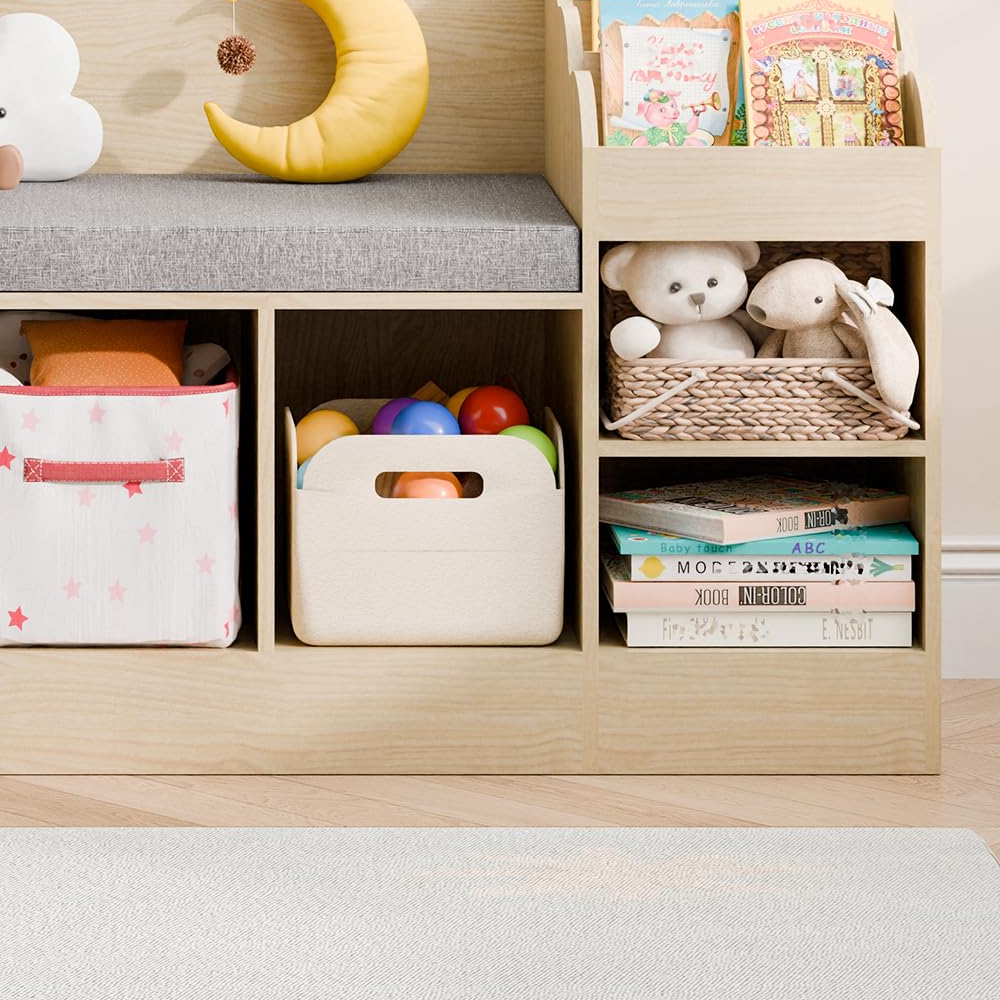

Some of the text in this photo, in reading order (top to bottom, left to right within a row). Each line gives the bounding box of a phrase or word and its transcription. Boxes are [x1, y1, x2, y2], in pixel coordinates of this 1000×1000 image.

[776, 516, 799, 532] BOOK
[660, 543, 691, 554] Baby
[791, 542, 825, 554] ABC
[694, 588, 729, 606] BOOK
[835, 618, 874, 641] NESBIT
